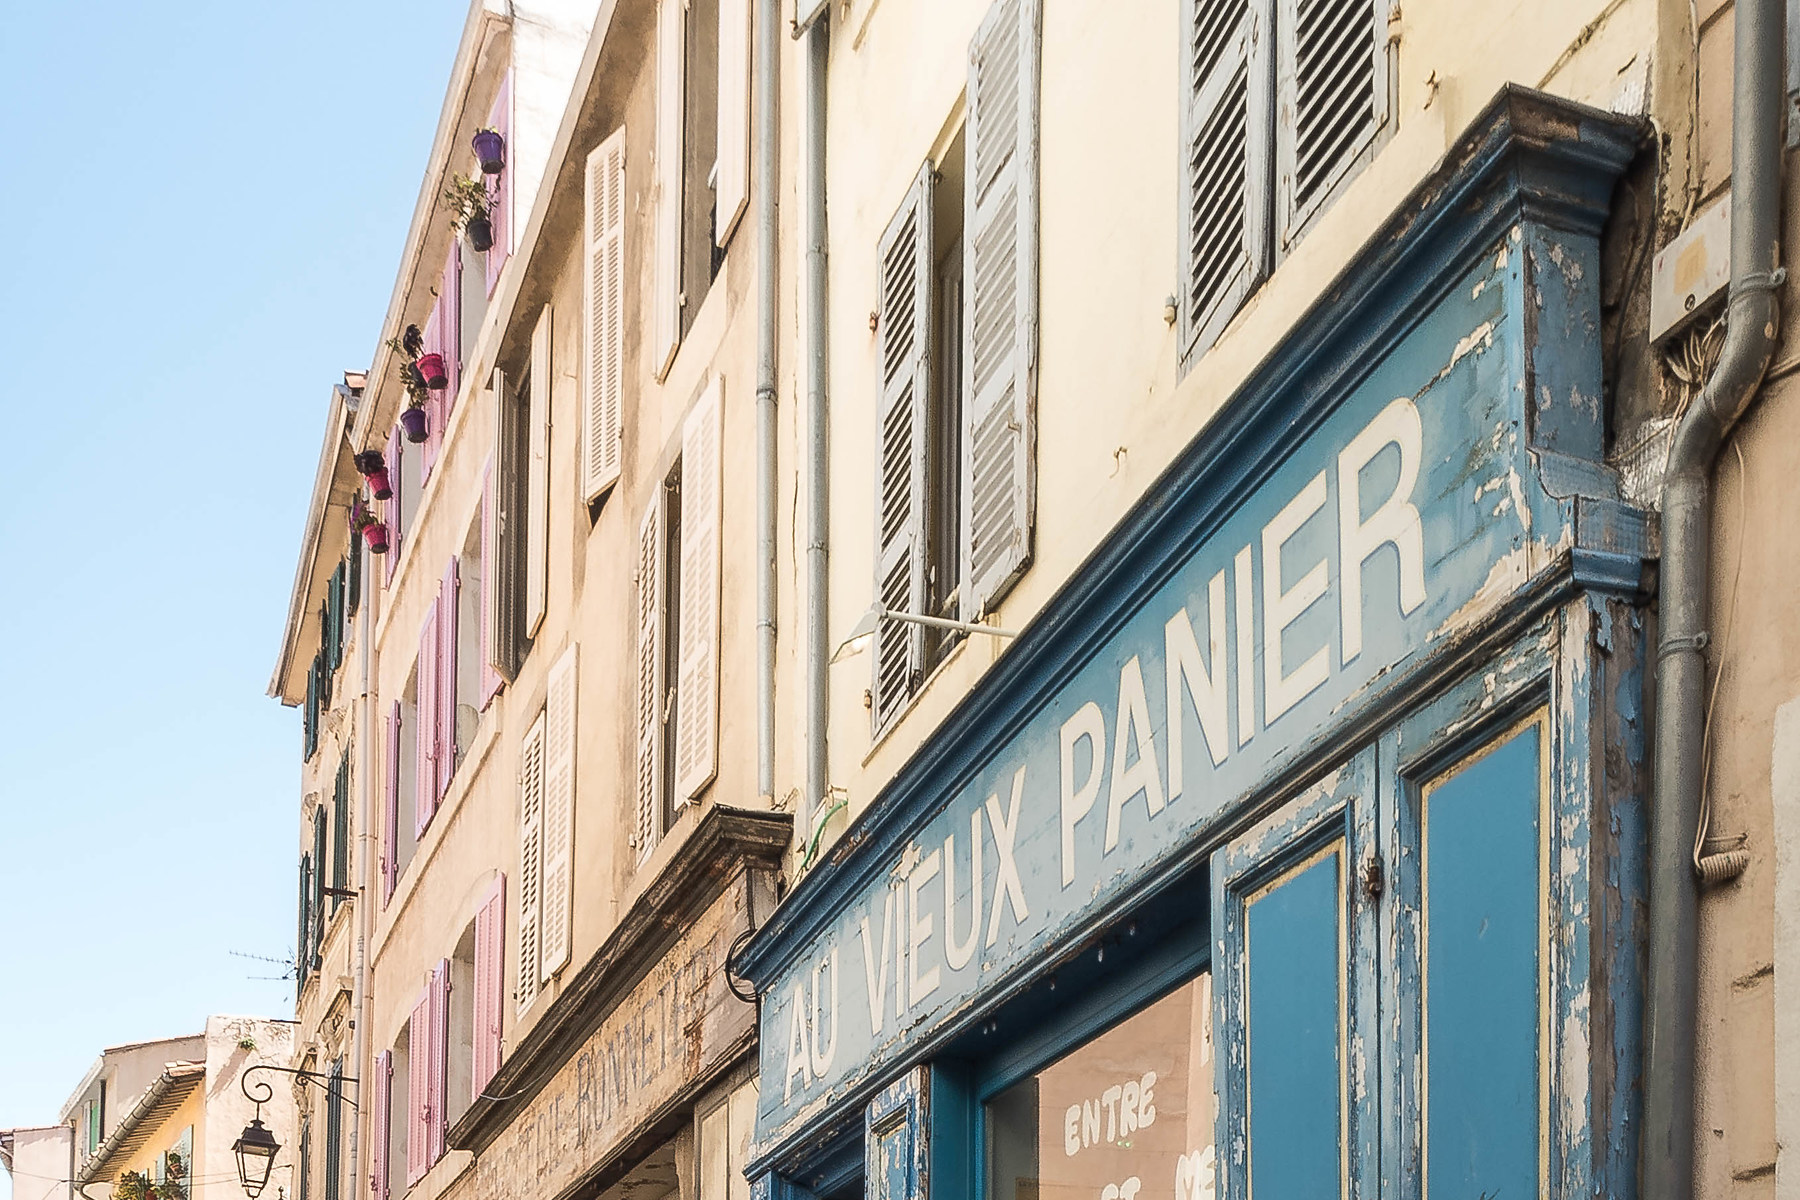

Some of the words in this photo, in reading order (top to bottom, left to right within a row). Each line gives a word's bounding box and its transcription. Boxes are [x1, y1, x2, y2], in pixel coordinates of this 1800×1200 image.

[783, 945, 838, 1106] AU
[860, 764, 1030, 1038] VIEUX
[1059, 396, 1427, 893] PANIER
[1064, 1070, 1158, 1157] ENTRE
